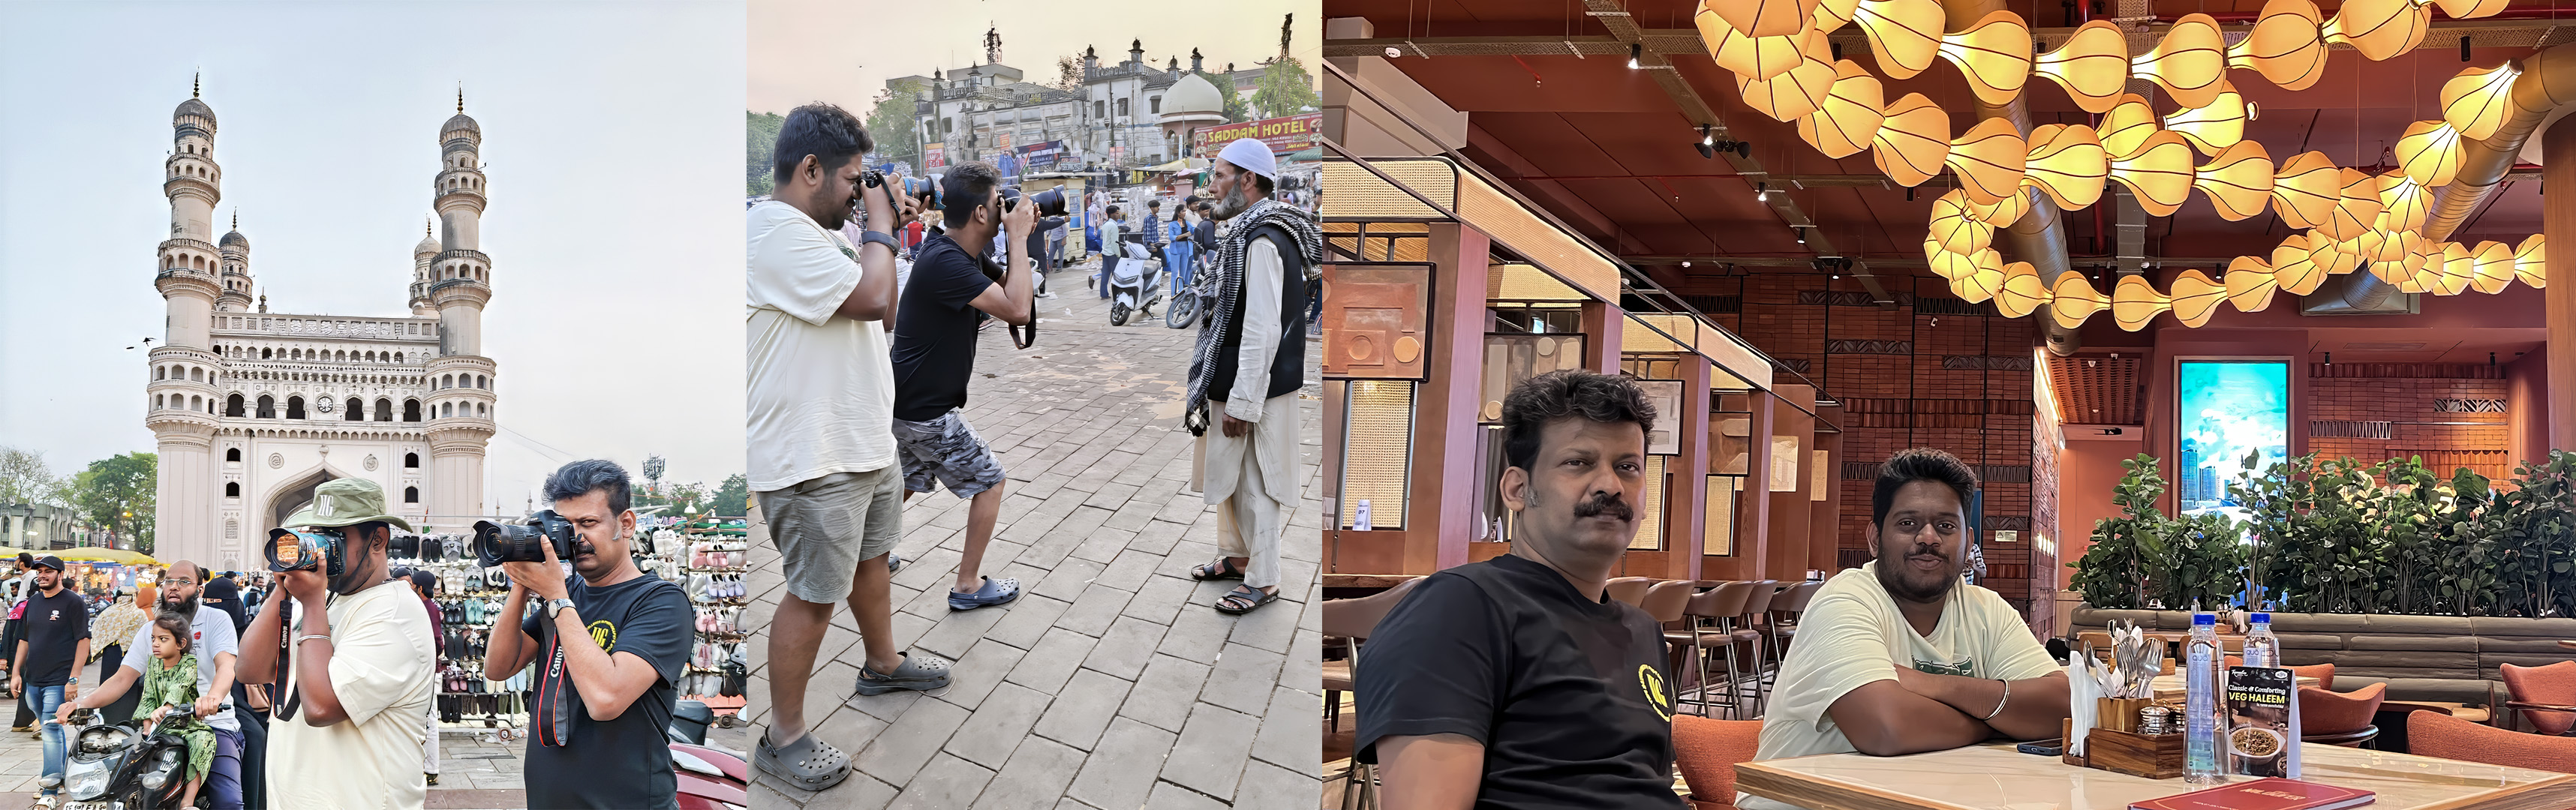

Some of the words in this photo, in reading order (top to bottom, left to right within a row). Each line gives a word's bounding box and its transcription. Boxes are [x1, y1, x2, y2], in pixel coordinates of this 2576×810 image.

[1208, 126, 1258, 142] SADDAM
[1262, 120, 1307, 137] HOTEL
[550, 646, 563, 678] Canon
[2229, 692, 2247, 701] VEG
[2249, 694, 2286, 704] HALEEM
[2255, 686, 2286, 695] Comforting
